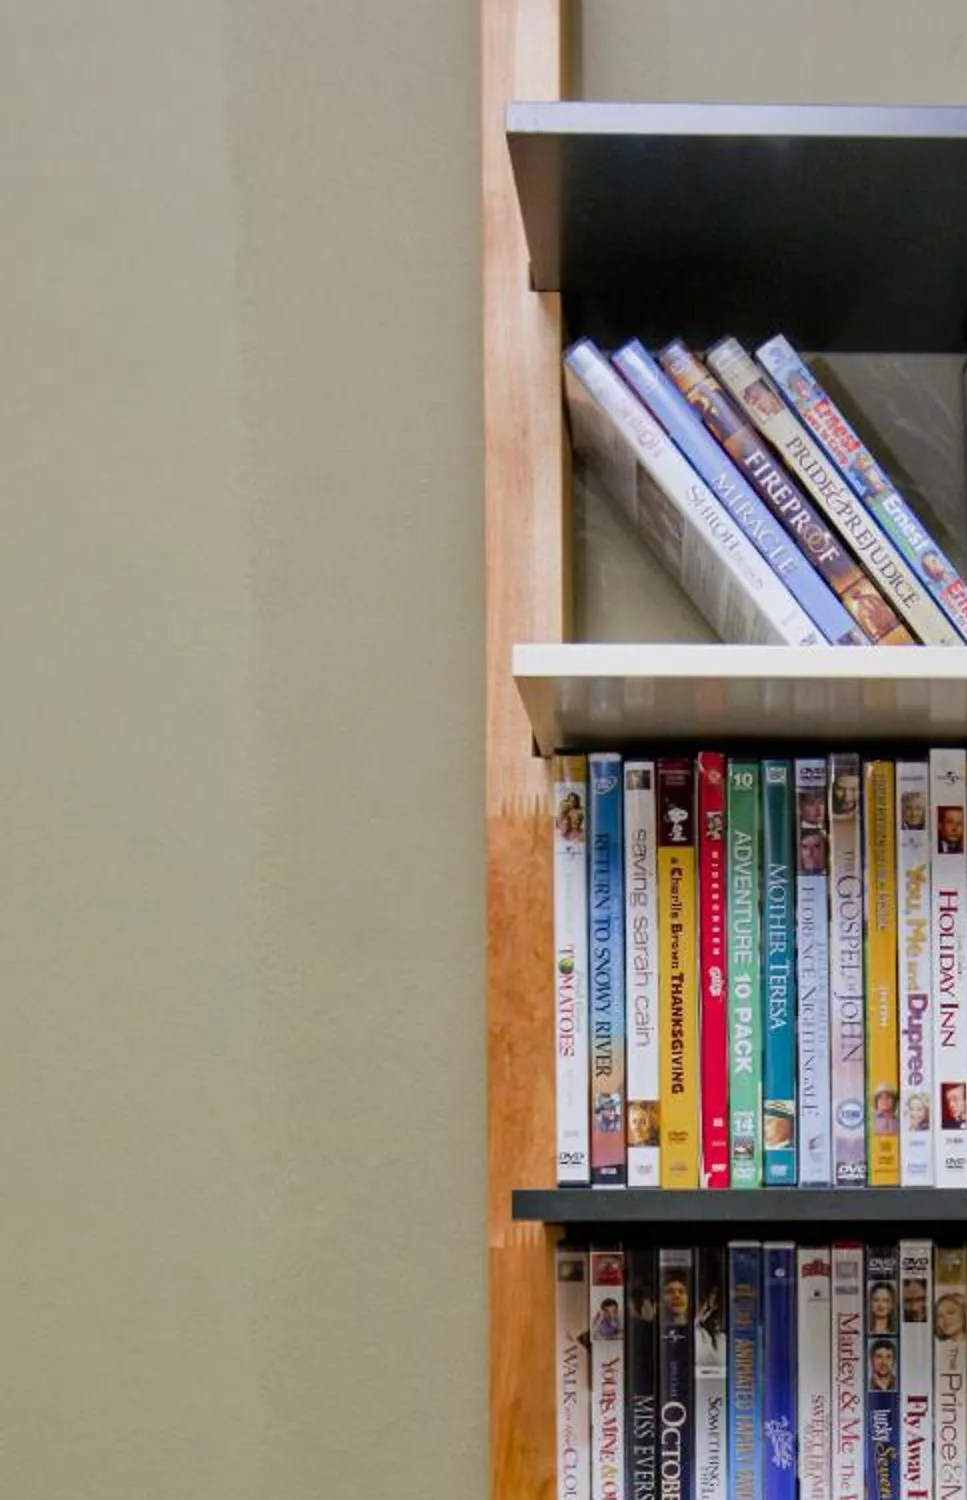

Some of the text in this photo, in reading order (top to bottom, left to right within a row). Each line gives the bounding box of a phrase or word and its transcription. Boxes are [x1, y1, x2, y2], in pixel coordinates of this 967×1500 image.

[712, 470, 799, 577] MIRACLE
[743, 450, 842, 564] FIREPROOF
[595, 834, 612, 1078] RETURN TO SNOWY RIVER
[631, 830, 655, 1047] saving sarah cain
[733, 832, 752, 1073] ADVENTURE 10 PACK
[769, 864, 791, 1030] MOTHER TERESA
[907, 917, 927, 958] Me
[939, 891, 960, 1048] HOLIDAY INN
[801, 888, 818, 1118] FLORENCE NIGHTINGALE
[903, 994, 928, 1085] Dupree
[835, 1313, 859, 1386] Marley
[633, 1395, 655, 1439] MISS
[838, 1388, 858, 1413] &
[905, 1395, 928, 1428] Fly
[941, 1373, 963, 1461] Prince
[840, 1463, 856, 1489] The
[904, 1432, 925, 1483] Away
